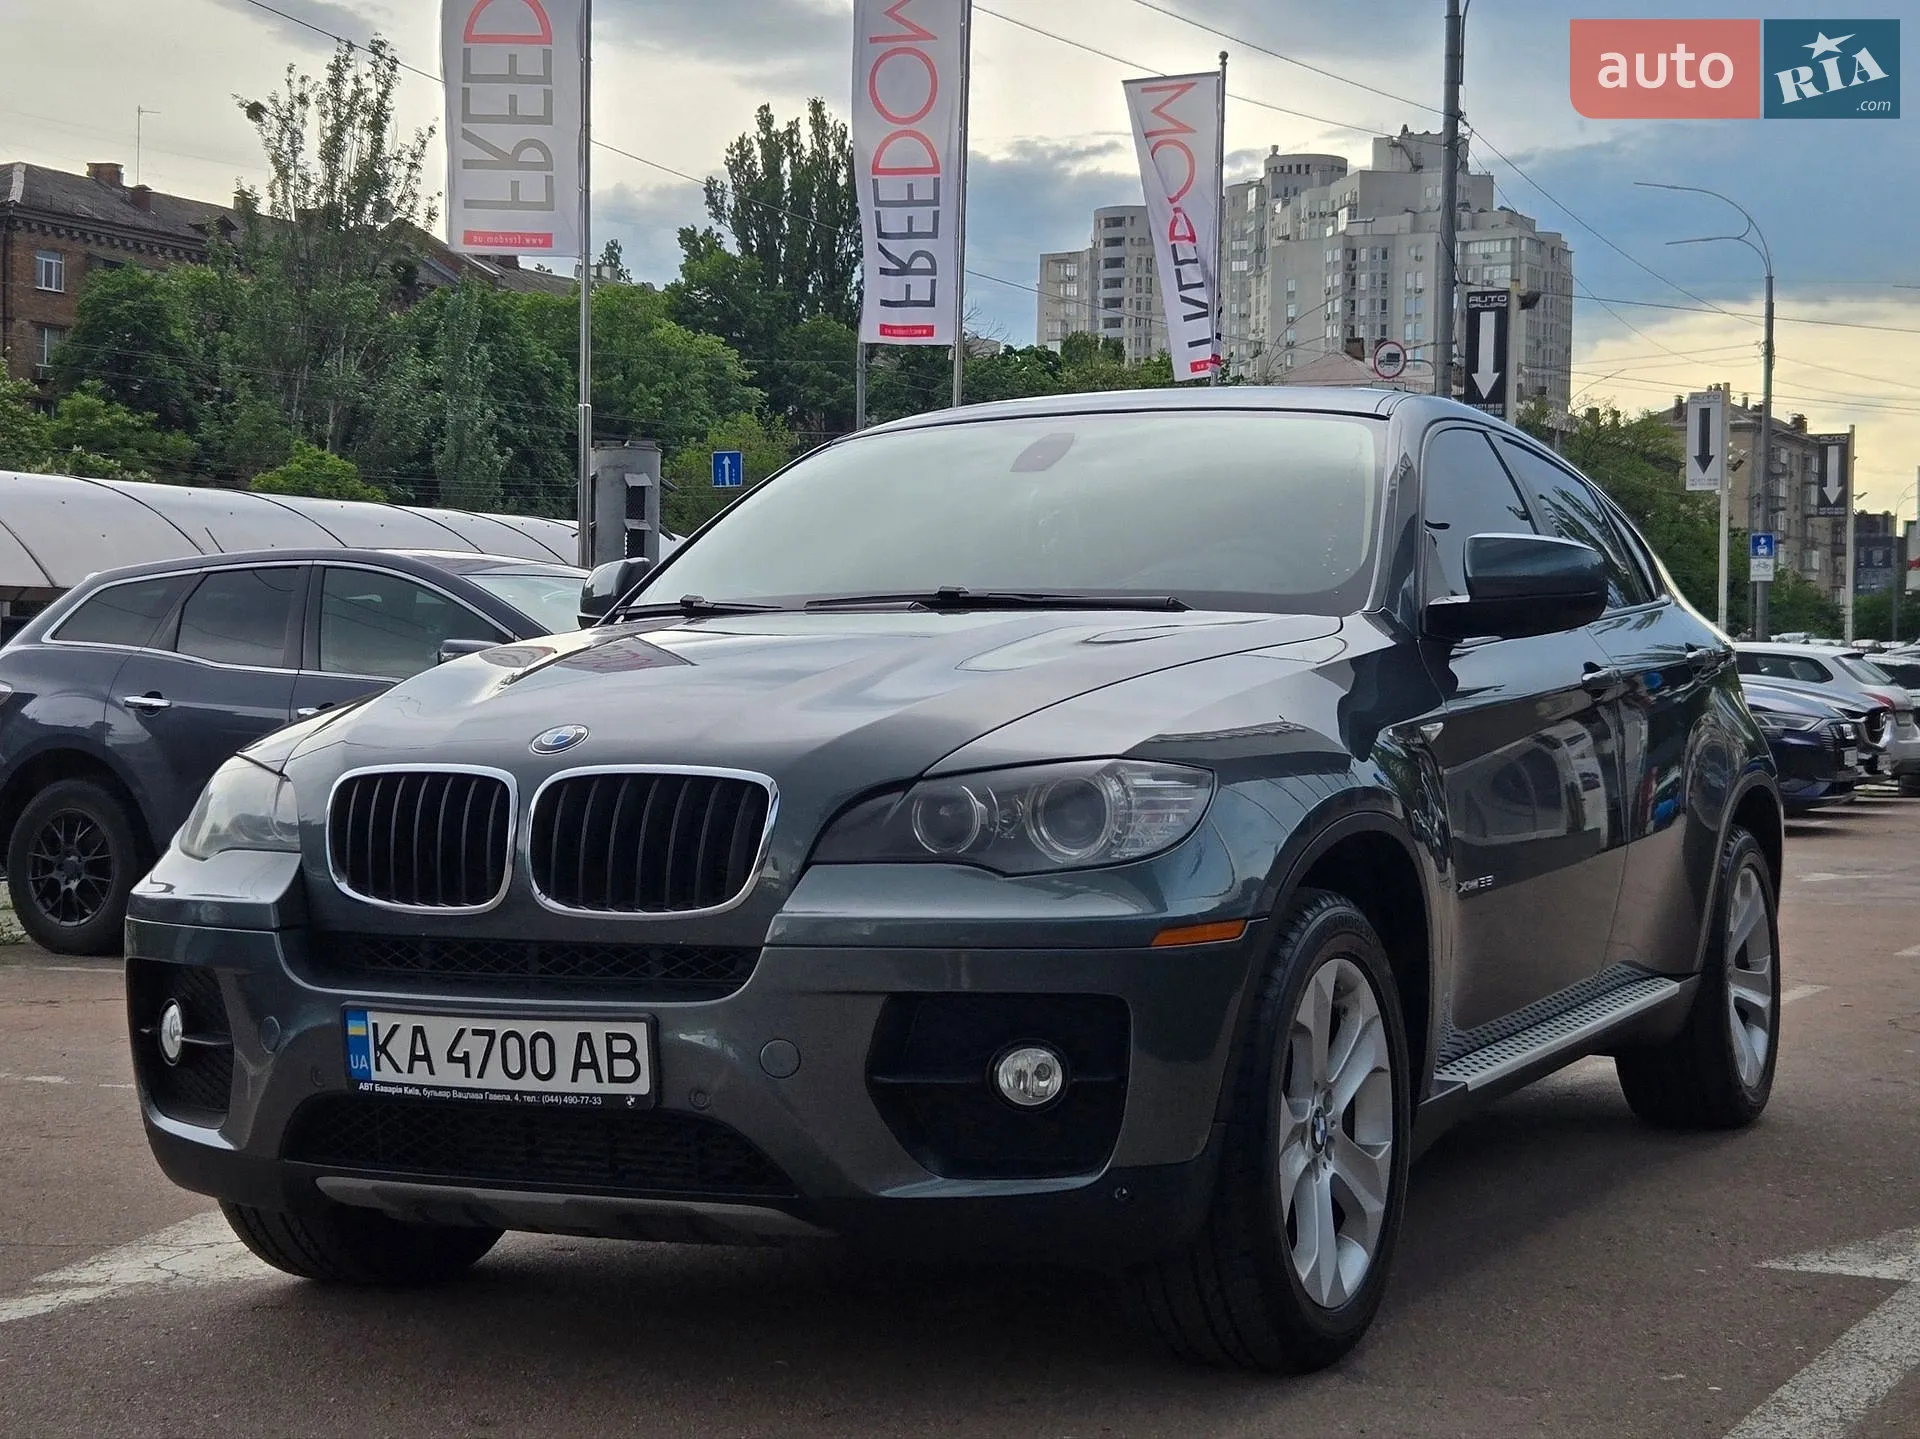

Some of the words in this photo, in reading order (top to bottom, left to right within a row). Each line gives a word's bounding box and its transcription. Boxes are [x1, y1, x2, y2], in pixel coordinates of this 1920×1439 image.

[1469, 295, 1507, 303] AUTO
[371, 1021, 436, 1076] KA
[446, 1027, 556, 1082] 4700
[570, 1031, 642, 1084] AB
[350, 1054, 369, 1071] UA
[541, 1094, 562, 1105] (044)
[563, 1095, 602, 1105] 490-77-33
